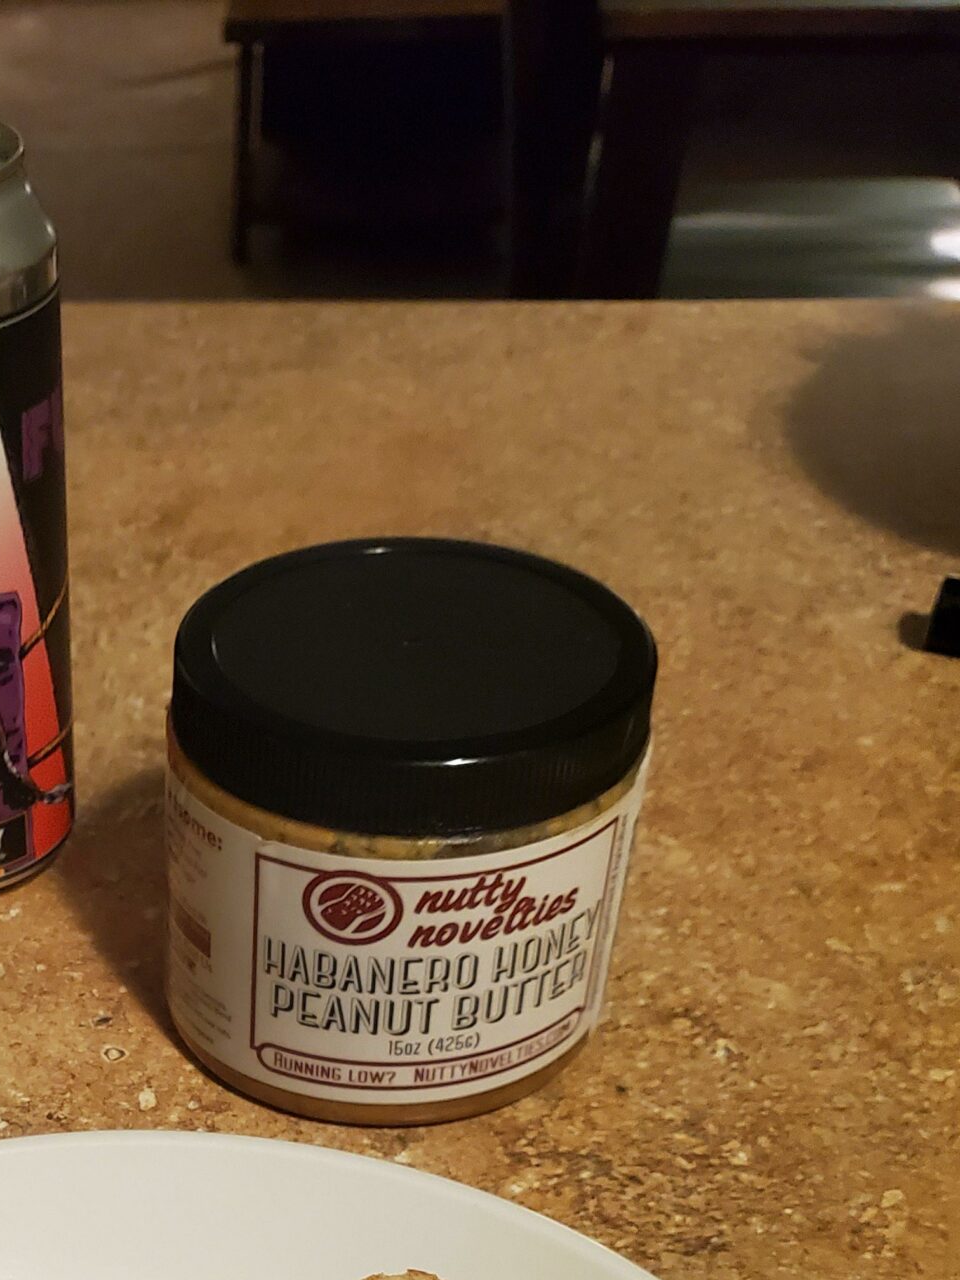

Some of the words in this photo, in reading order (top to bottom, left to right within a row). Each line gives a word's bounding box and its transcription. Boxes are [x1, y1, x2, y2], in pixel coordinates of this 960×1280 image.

[407, 887, 579, 949] novelties
[414, 873, 527, 915] nutty
[263, 935, 480, 996] HABANERO
[491, 898, 602, 984] HONEY
[269, 980, 440, 1036] PEANUT
[451, 949, 588, 1031] BUTTER
[273, 1051, 342, 1081] RUNNING
[347, 1068, 397, 1084] LOW?
